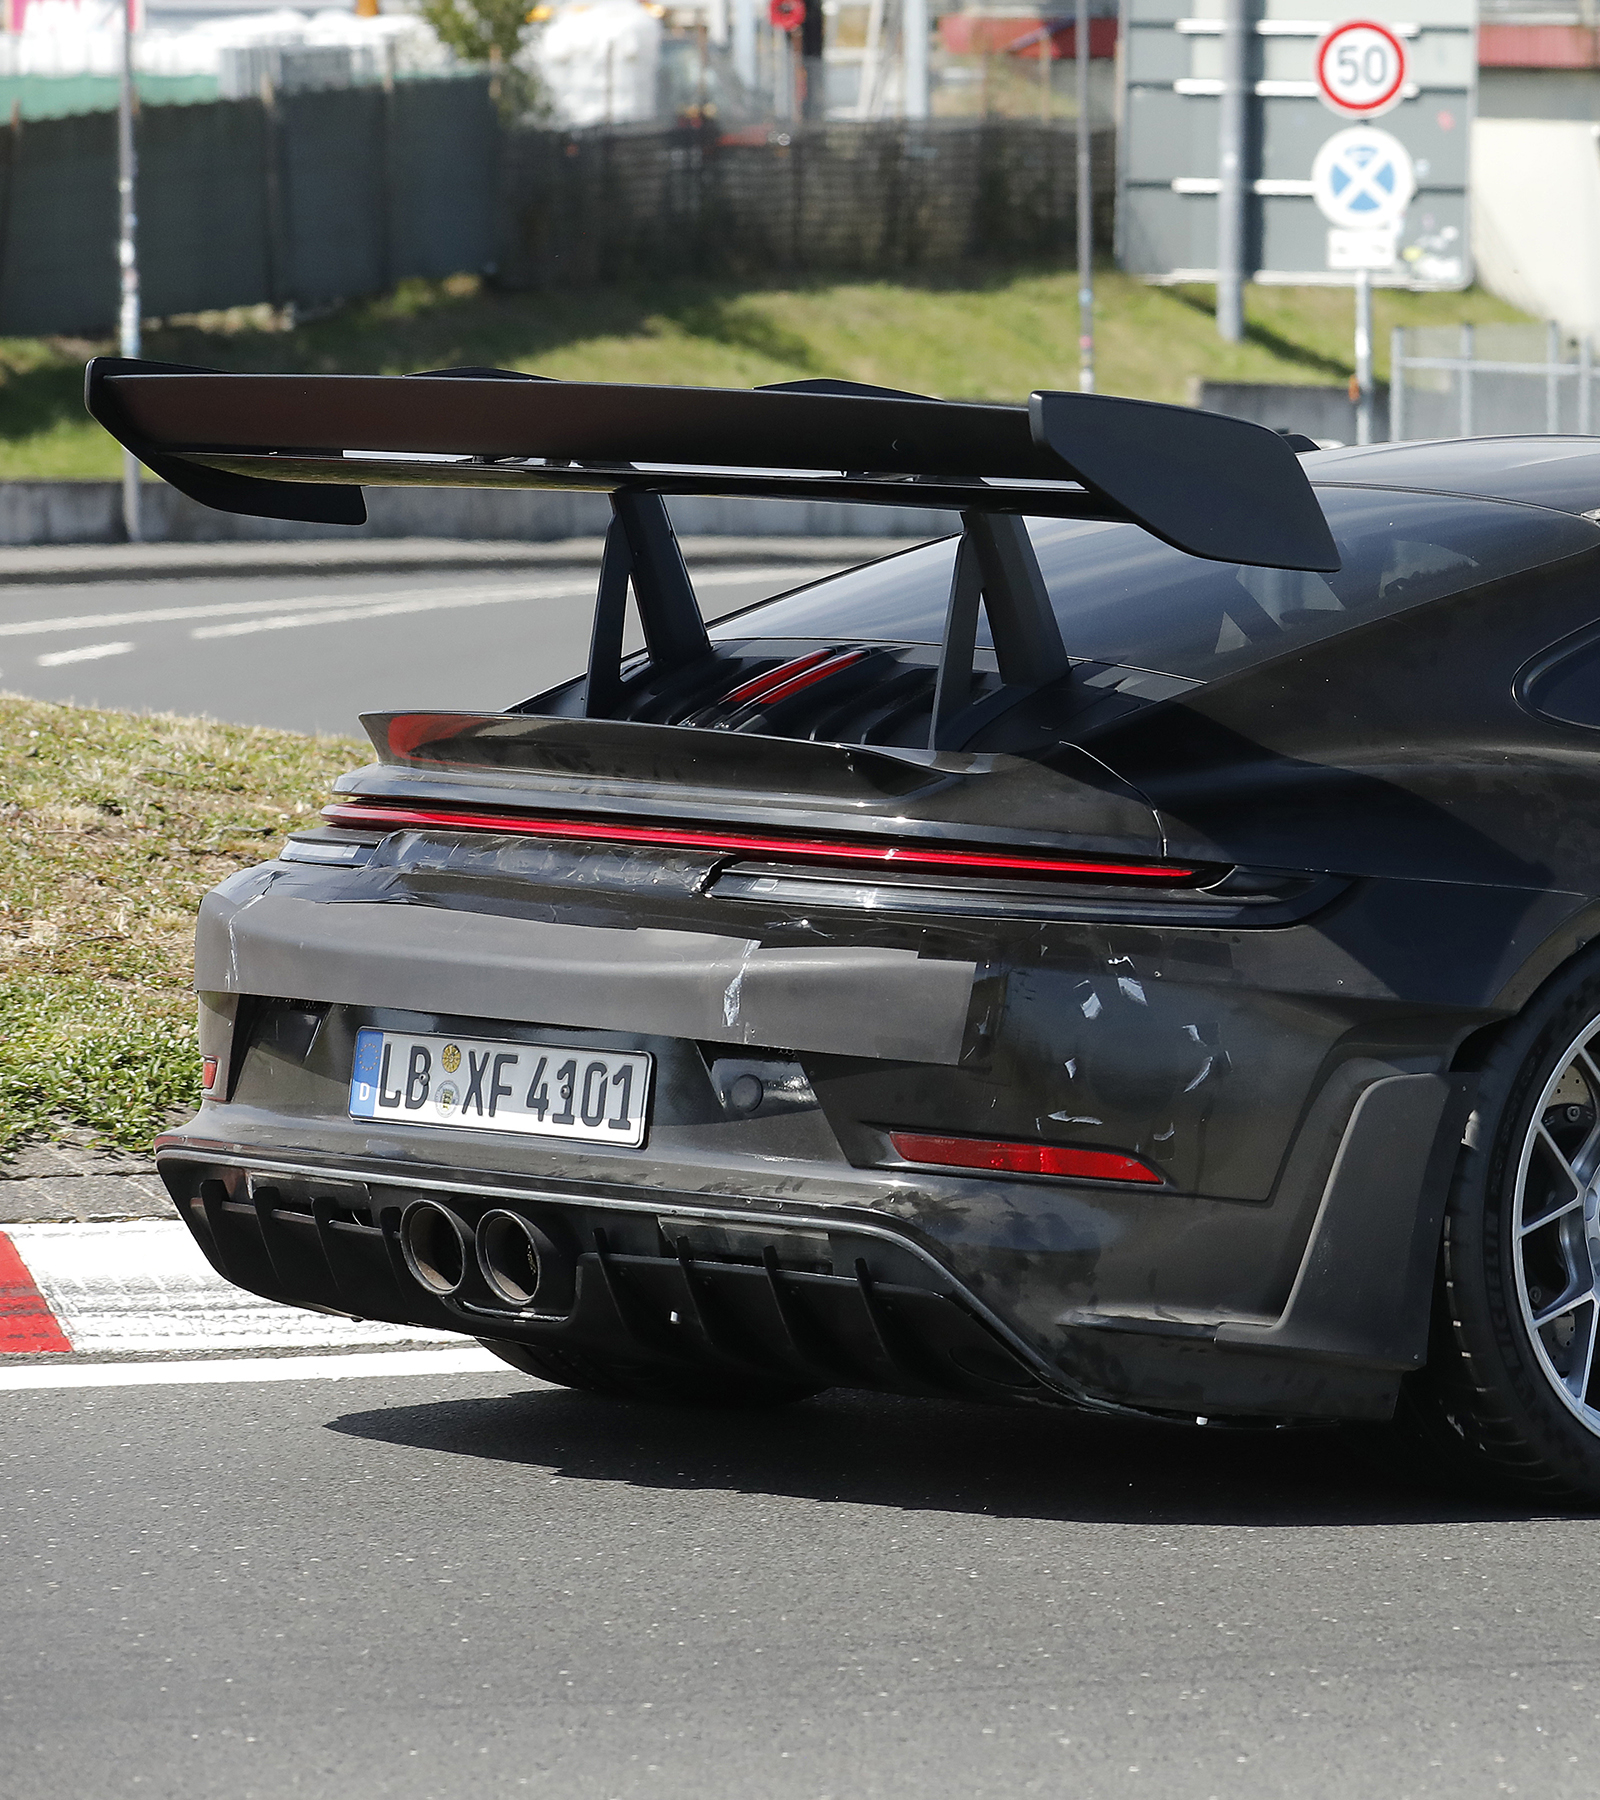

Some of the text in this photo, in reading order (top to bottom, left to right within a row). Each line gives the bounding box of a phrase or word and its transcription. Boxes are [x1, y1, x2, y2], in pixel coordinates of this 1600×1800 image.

[1337, 44, 1388, 86] 50
[359, 1082, 370, 1101] D
[378, 1043, 633, 1131] LB XF 4101
